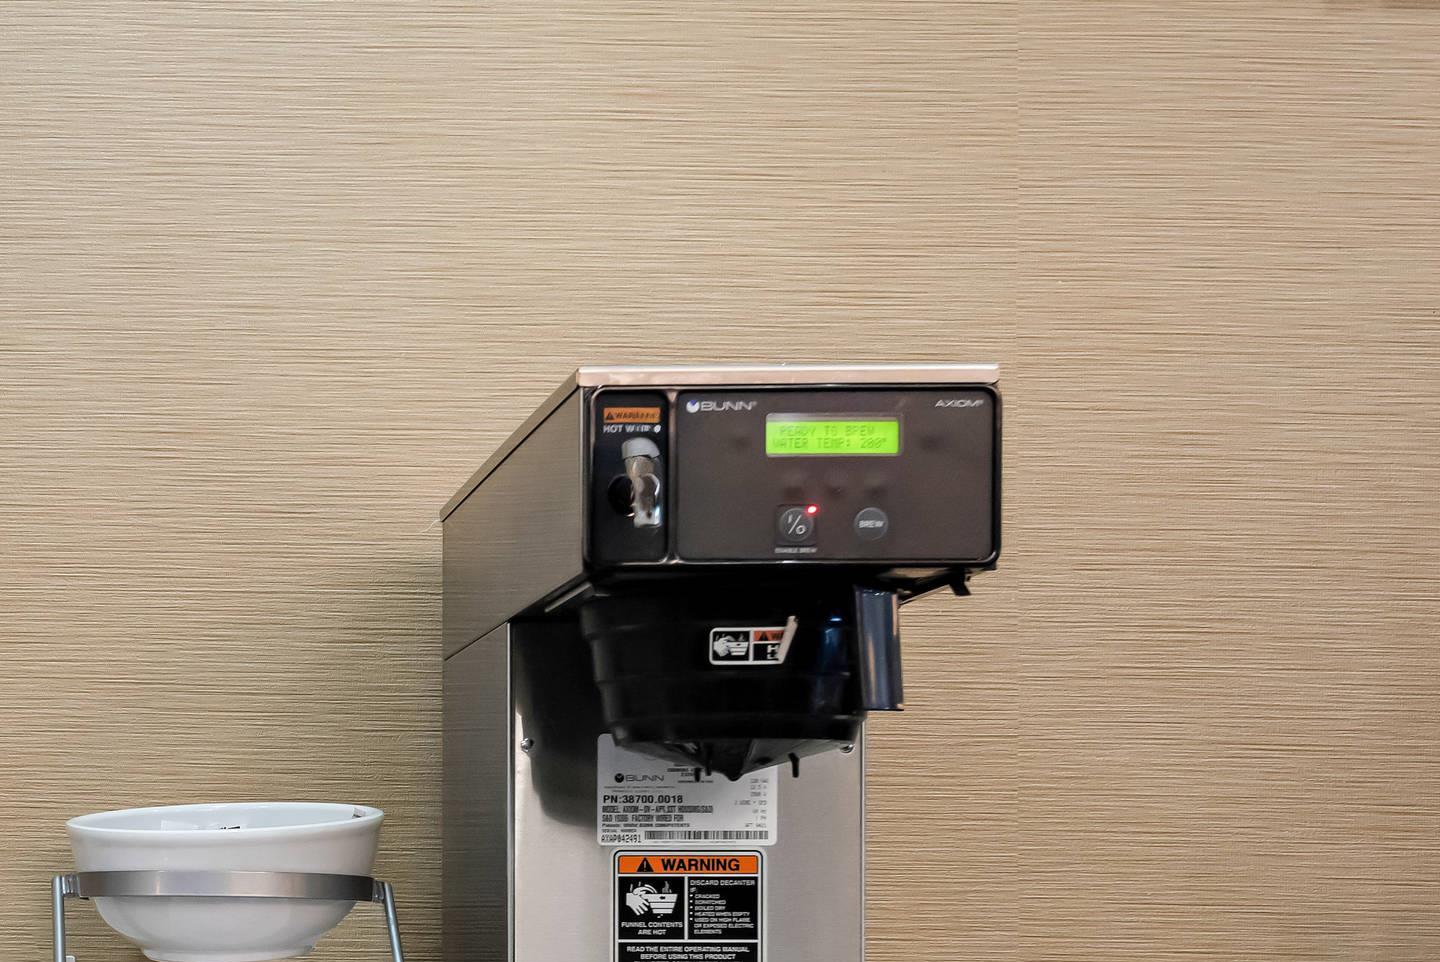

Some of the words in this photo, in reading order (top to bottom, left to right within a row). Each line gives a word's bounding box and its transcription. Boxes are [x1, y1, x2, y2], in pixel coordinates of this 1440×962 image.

[603, 424, 623, 433] HOT
[824, 425, 838, 437] TO
[858, 520, 884, 528] BREW
[625, 774, 665, 782] BUNN
[603, 795, 683, 804] PN:38700.0018
[661, 858, 740, 871] WARNING
